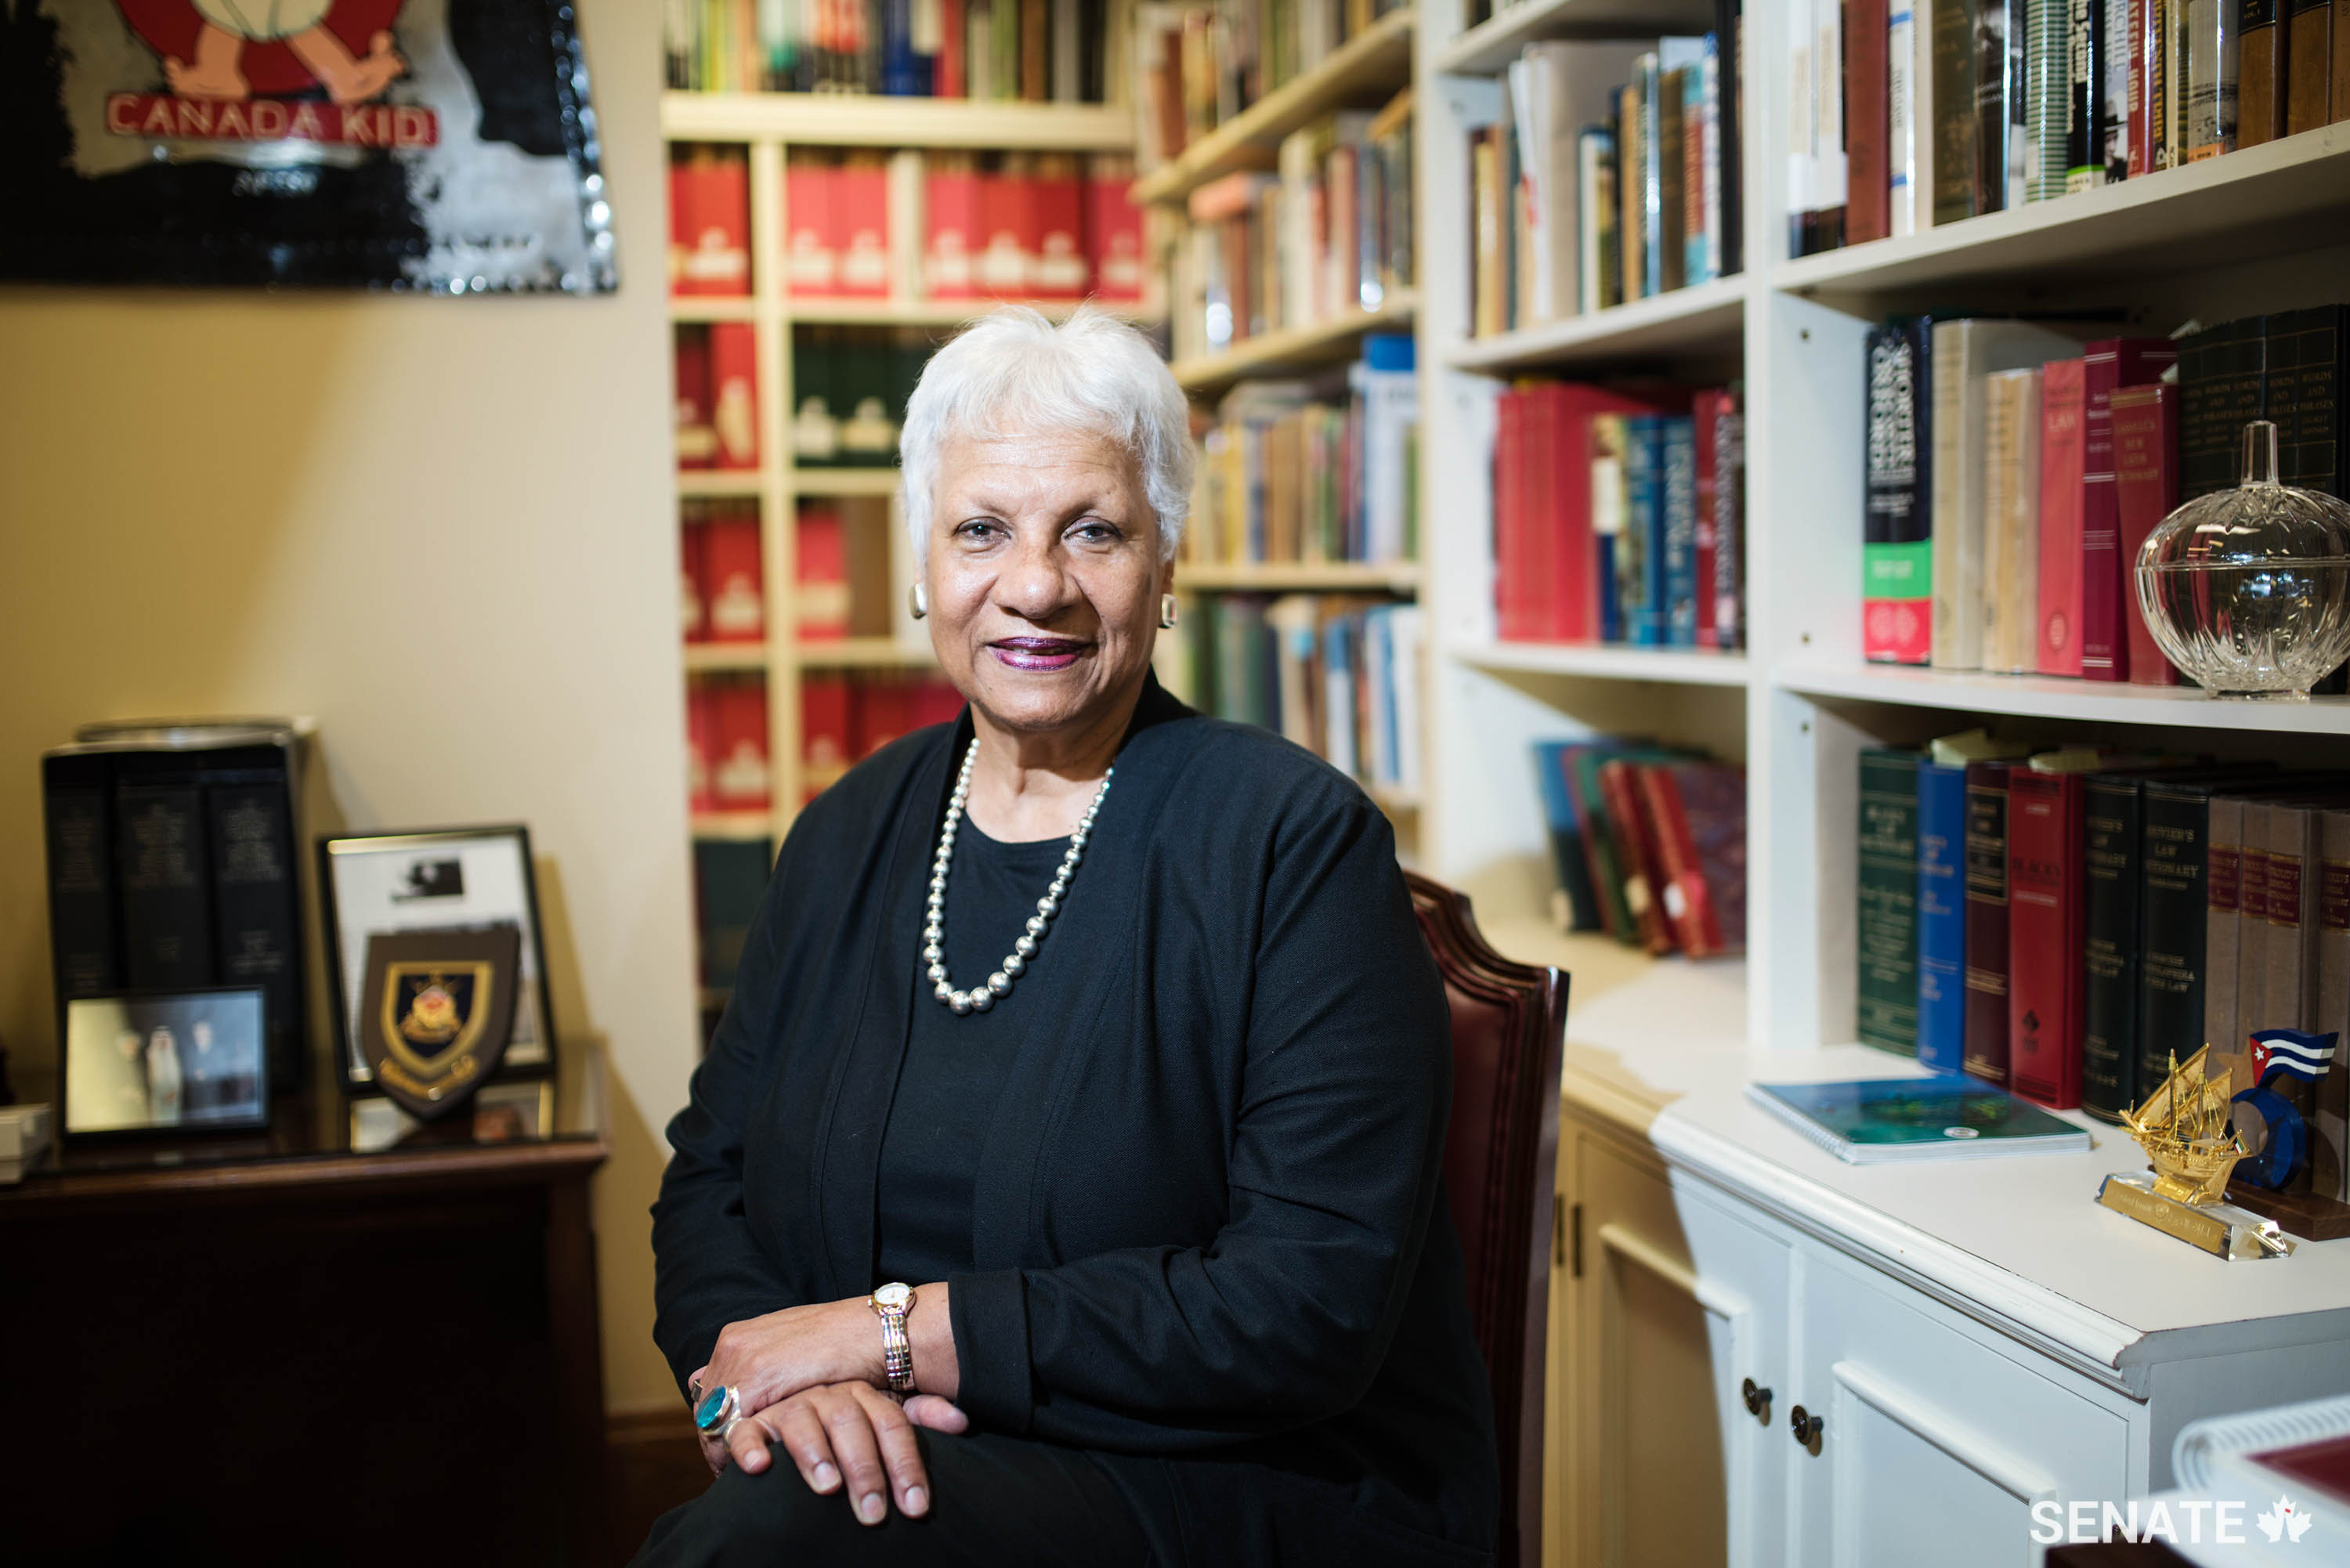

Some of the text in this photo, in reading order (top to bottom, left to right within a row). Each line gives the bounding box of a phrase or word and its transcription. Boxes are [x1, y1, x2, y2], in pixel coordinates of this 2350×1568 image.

[2128, 68, 2139, 112] HOUR
[107, 93, 430, 147] CANADA KID
